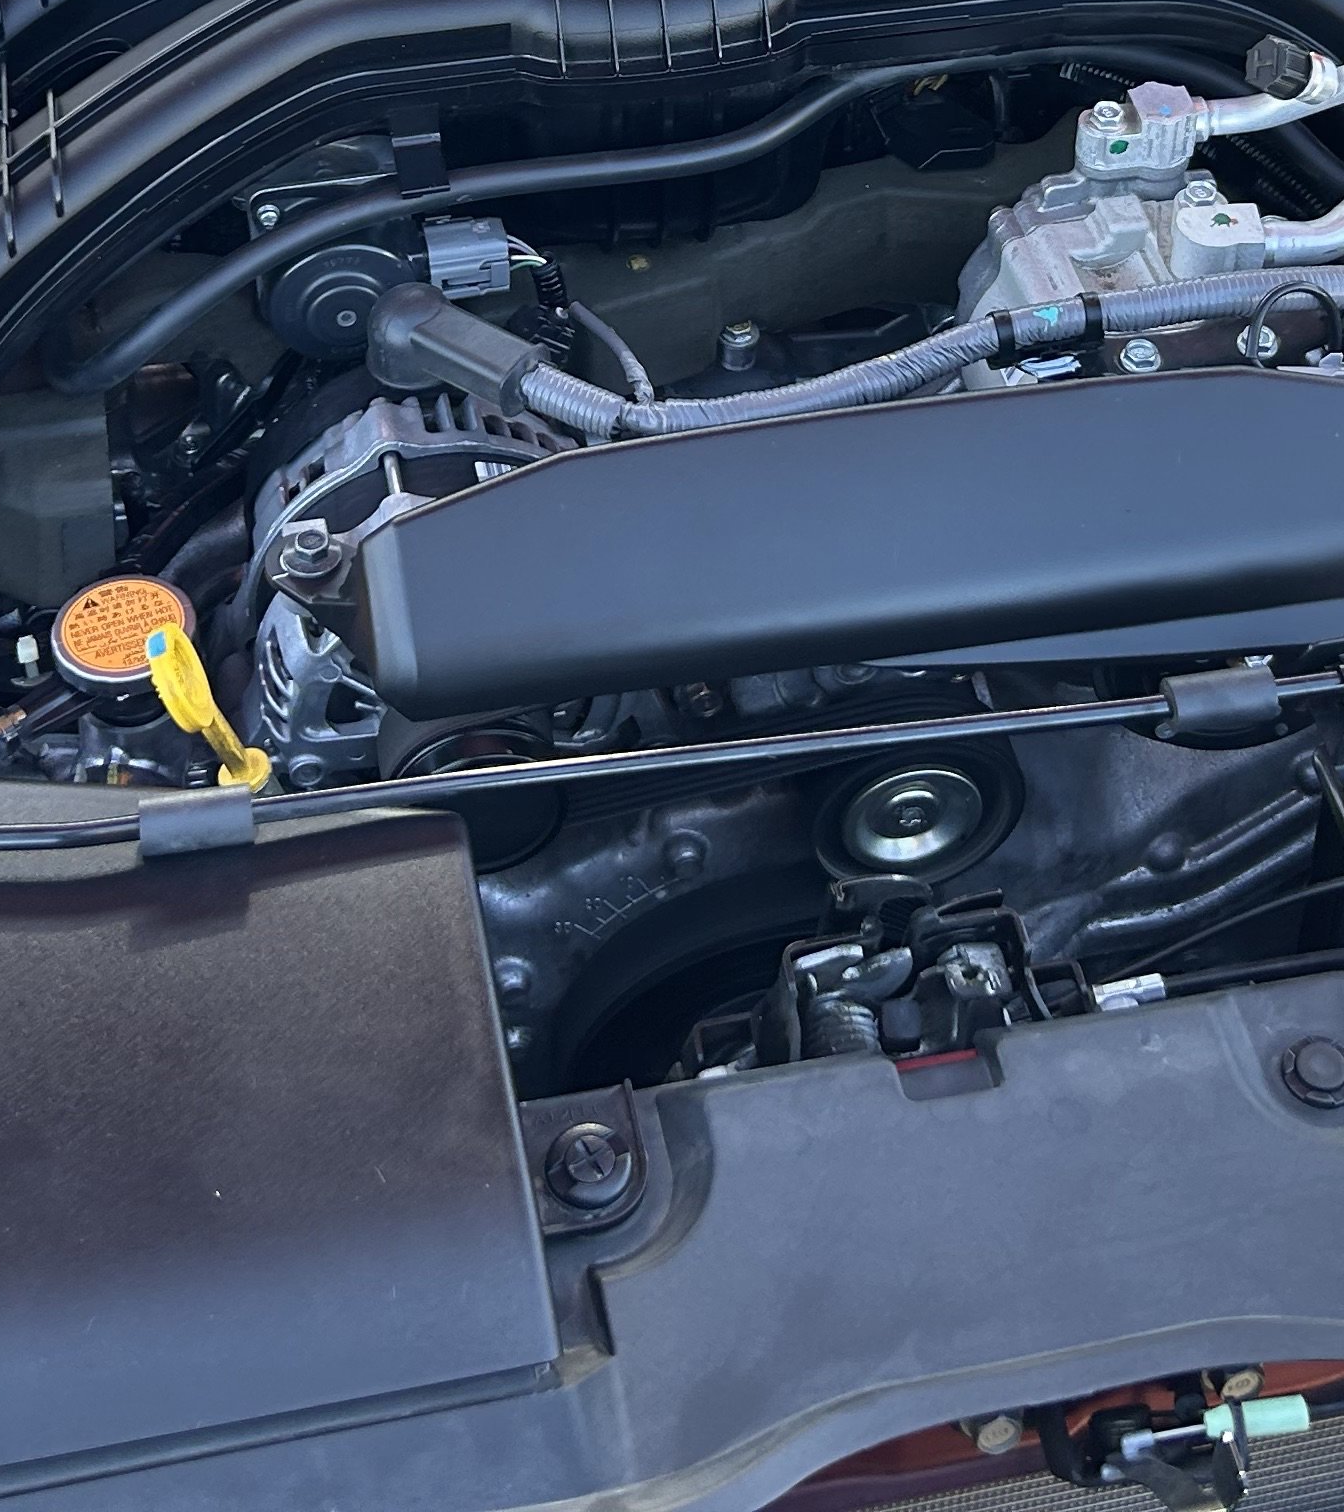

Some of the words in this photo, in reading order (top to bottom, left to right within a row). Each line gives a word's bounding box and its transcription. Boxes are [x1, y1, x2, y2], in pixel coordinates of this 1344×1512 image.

[70, 624, 99, 639] NEVER
[100, 618, 126, 631] OPEN
[127, 611, 154, 625] WHEN
[156, 604, 174, 617] HOT
[94, 638, 146, 659] AVERTISSE
